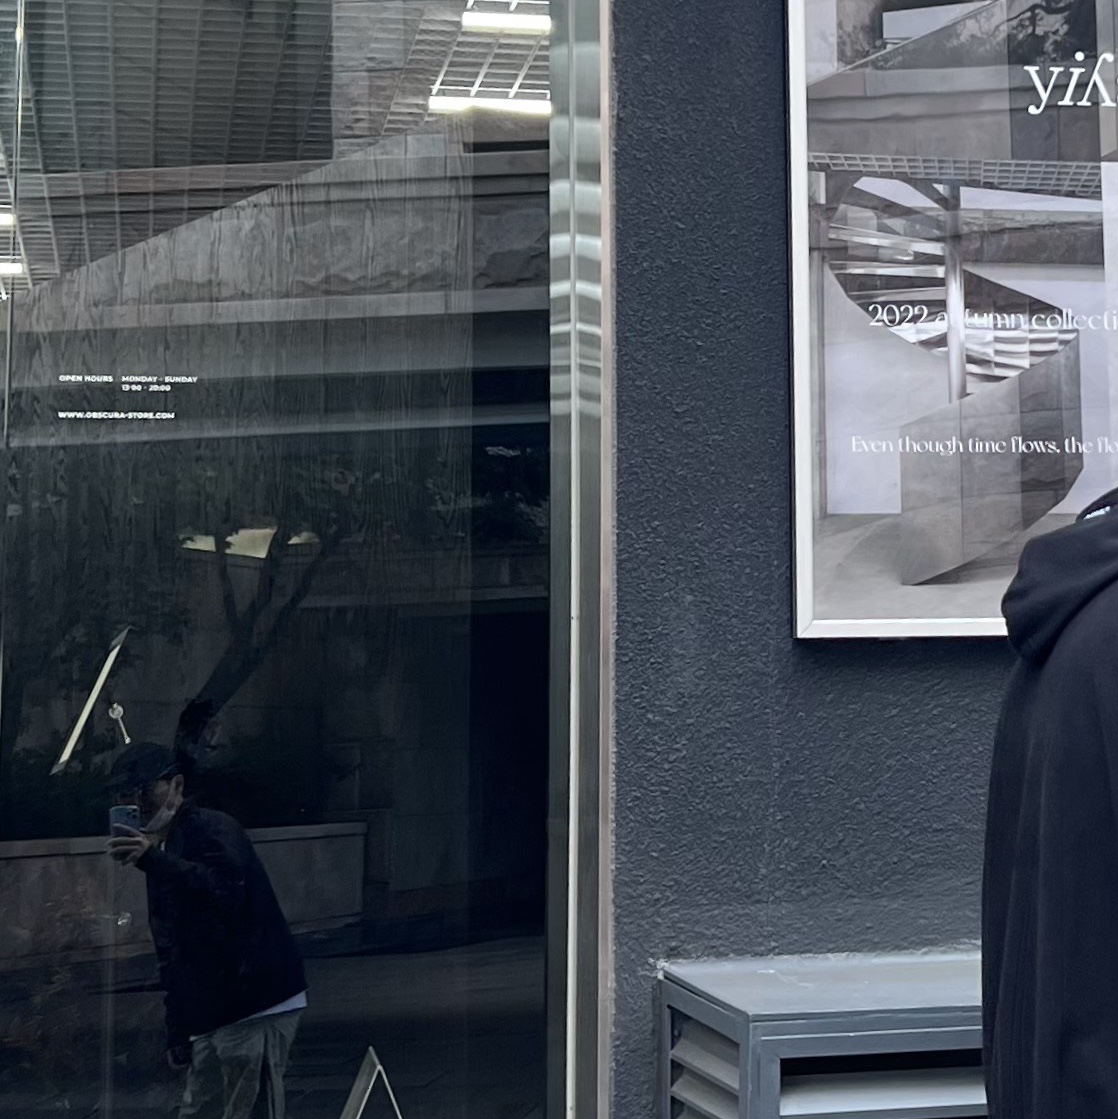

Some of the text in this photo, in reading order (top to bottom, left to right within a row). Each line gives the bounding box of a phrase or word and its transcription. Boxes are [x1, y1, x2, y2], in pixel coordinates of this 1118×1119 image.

[868, 304, 928, 327] 2022
[936, 308, 1023, 330] atumn
[851, 436, 893, 453] Even
[898, 436, 963, 456] though
[968, 437, 1007, 453] time
[1064, 436, 1093, 454] the
